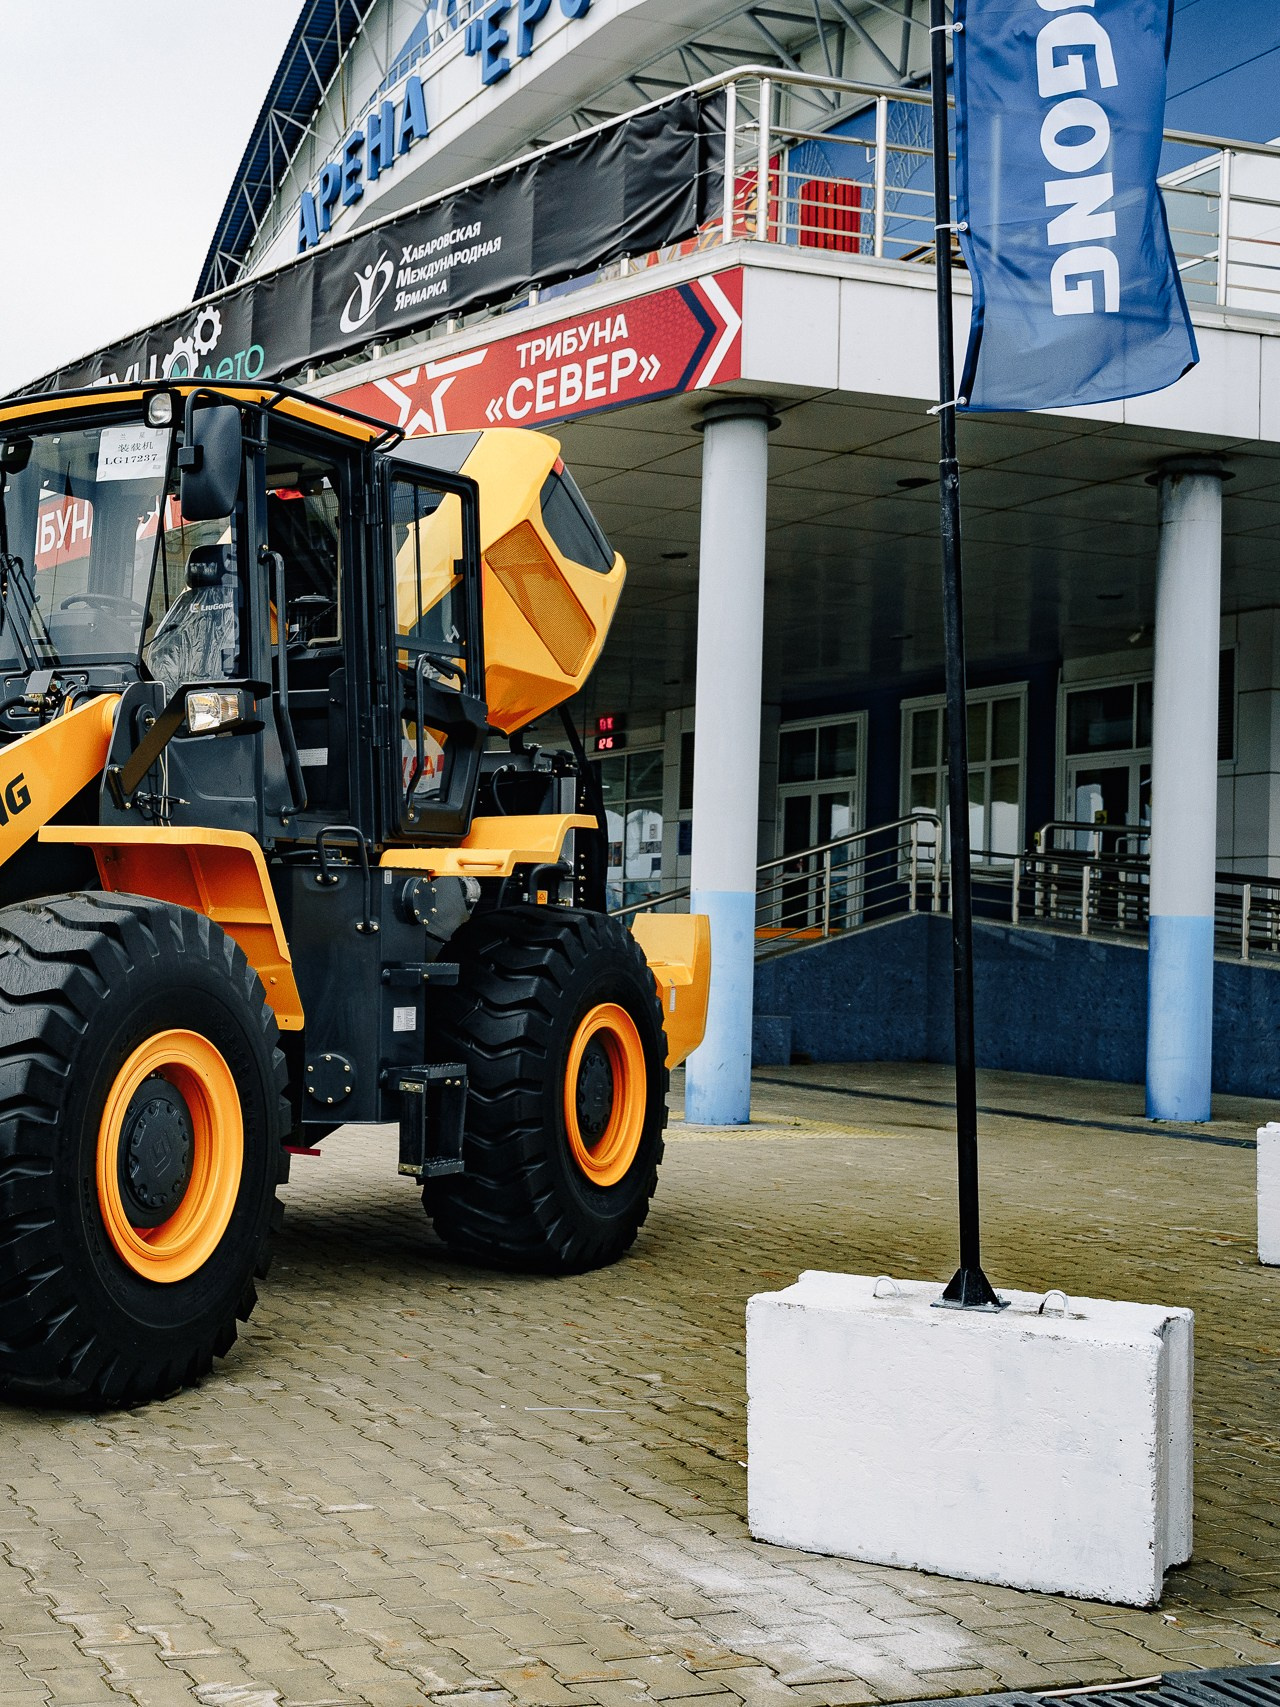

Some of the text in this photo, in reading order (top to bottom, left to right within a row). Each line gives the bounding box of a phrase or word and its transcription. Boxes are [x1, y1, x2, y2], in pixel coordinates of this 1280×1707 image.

[297, 0, 591, 254] АРЕНА "ЕР
[1035, 0, 1121, 316] GONG
[395, 236, 502, 289] МЕЖДУНАРОДНАЯ
[399, 221, 482, 266] ХАБАРОВСКАЯ
[394, 279, 448, 312] ЯРМАРКА
[516, 313, 629, 369] ТРИБУНА
[485, 347, 662, 423] «СЕВЕР»
[104, 453, 158, 465] LG17237
